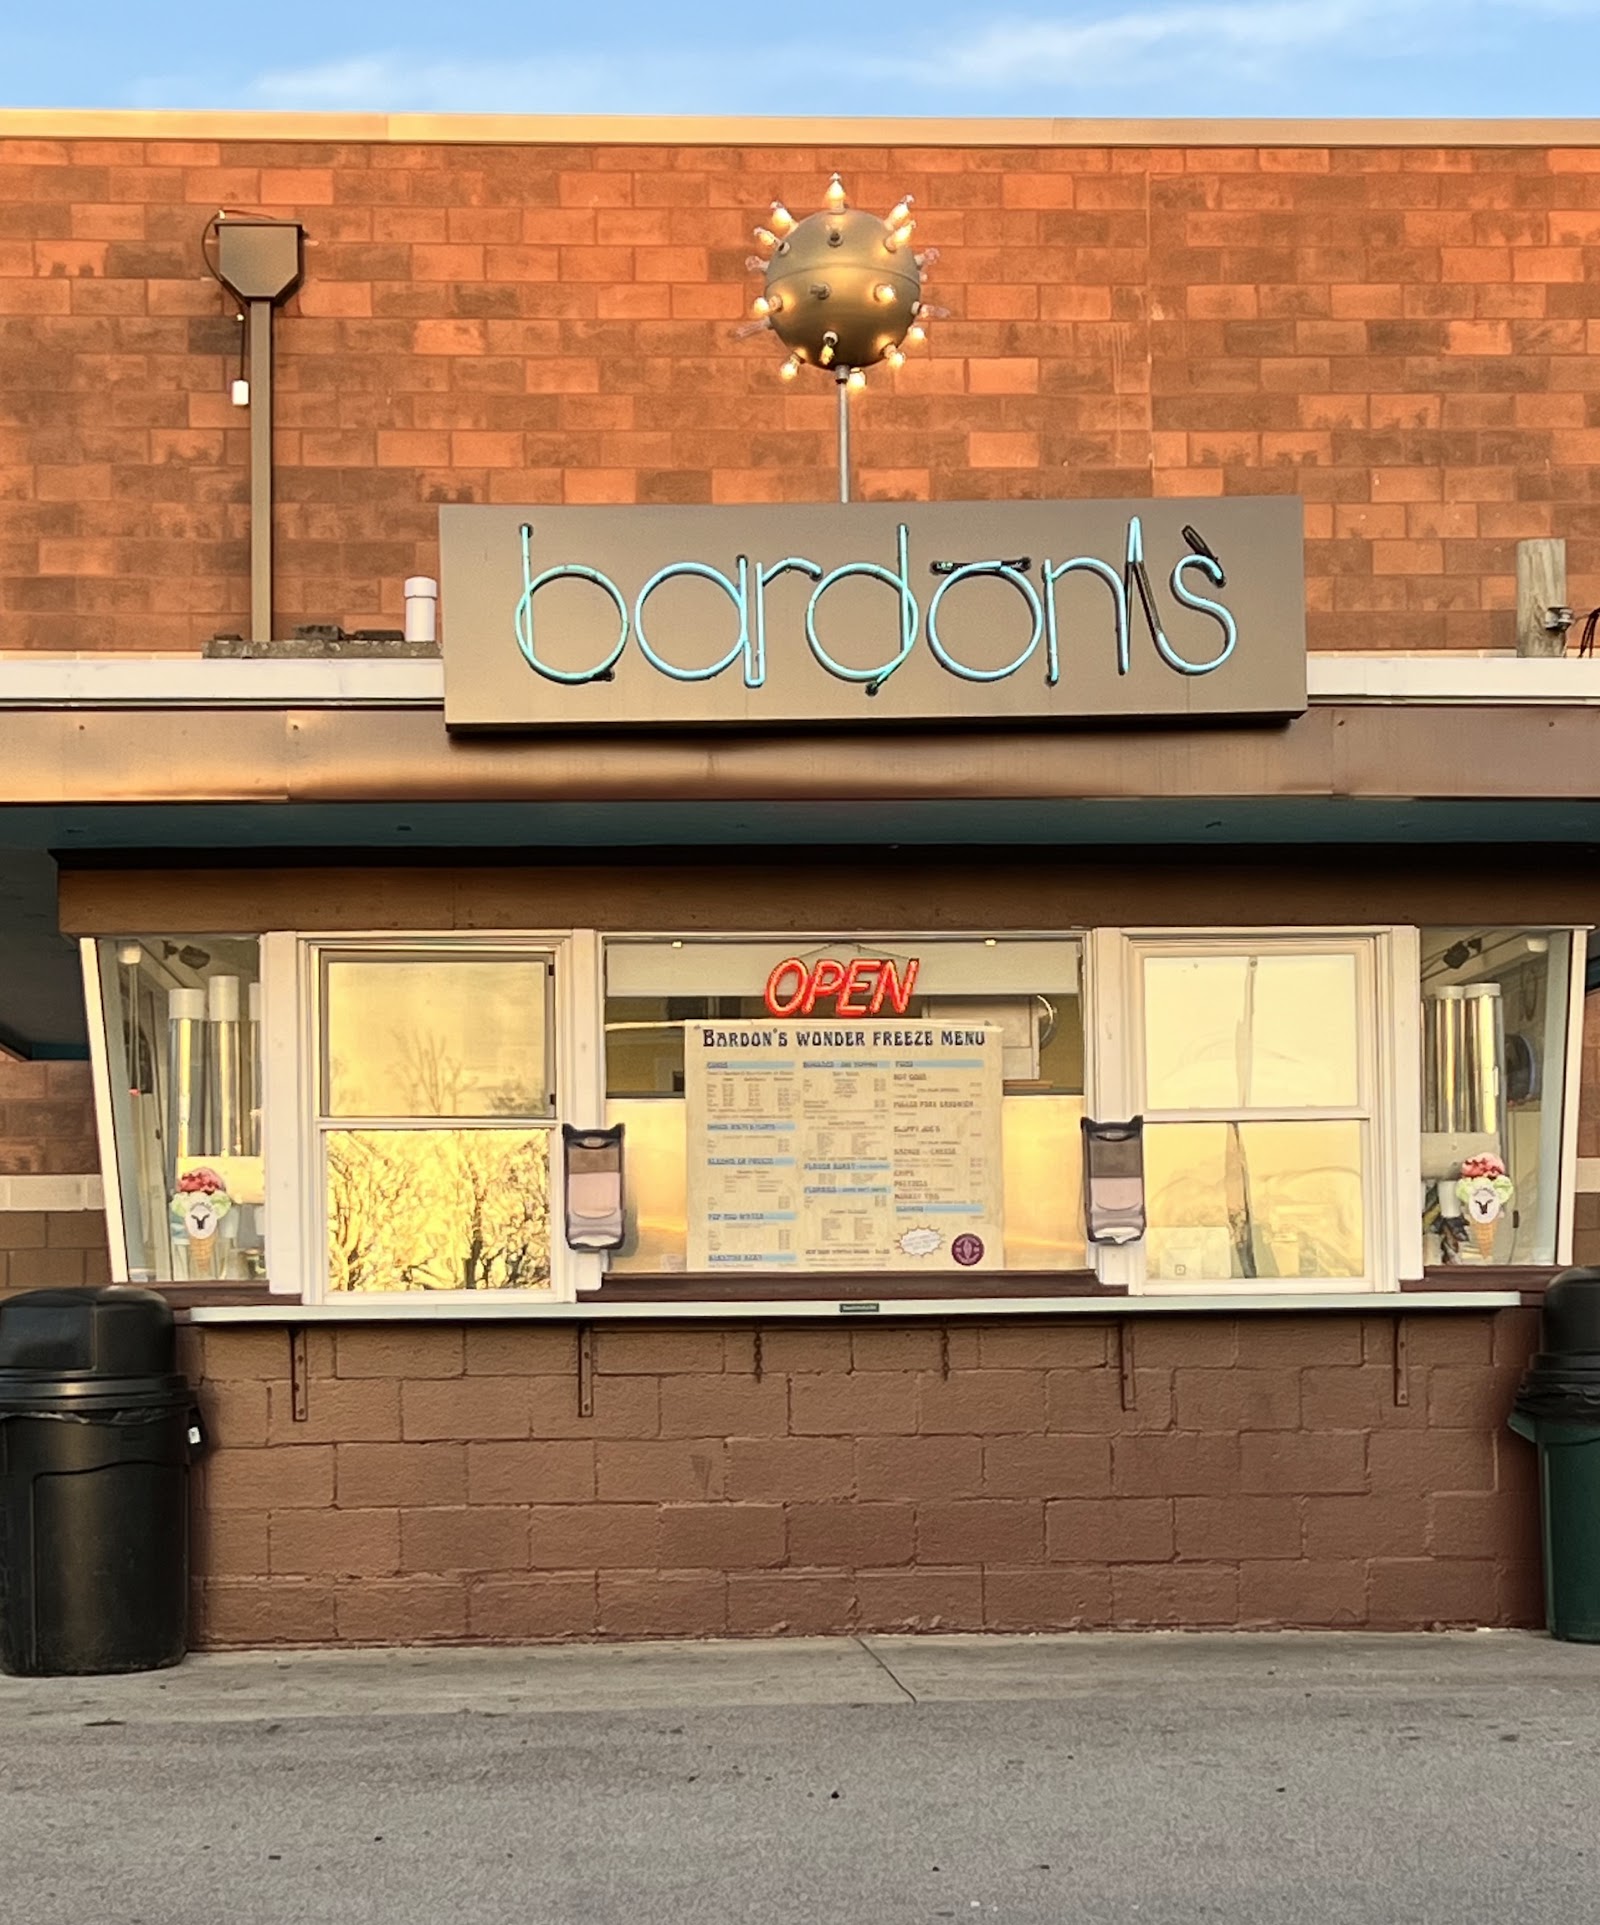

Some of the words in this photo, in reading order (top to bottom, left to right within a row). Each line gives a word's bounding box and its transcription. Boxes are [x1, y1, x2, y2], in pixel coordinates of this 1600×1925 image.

[765, 957, 919, 1017] OPEN
[702, 1028, 788, 1047] BARDON'S
[796, 1030, 865, 1046] WONDER
[873, 1030, 933, 1046] FREEZE
[941, 1030, 986, 1046] MENU
